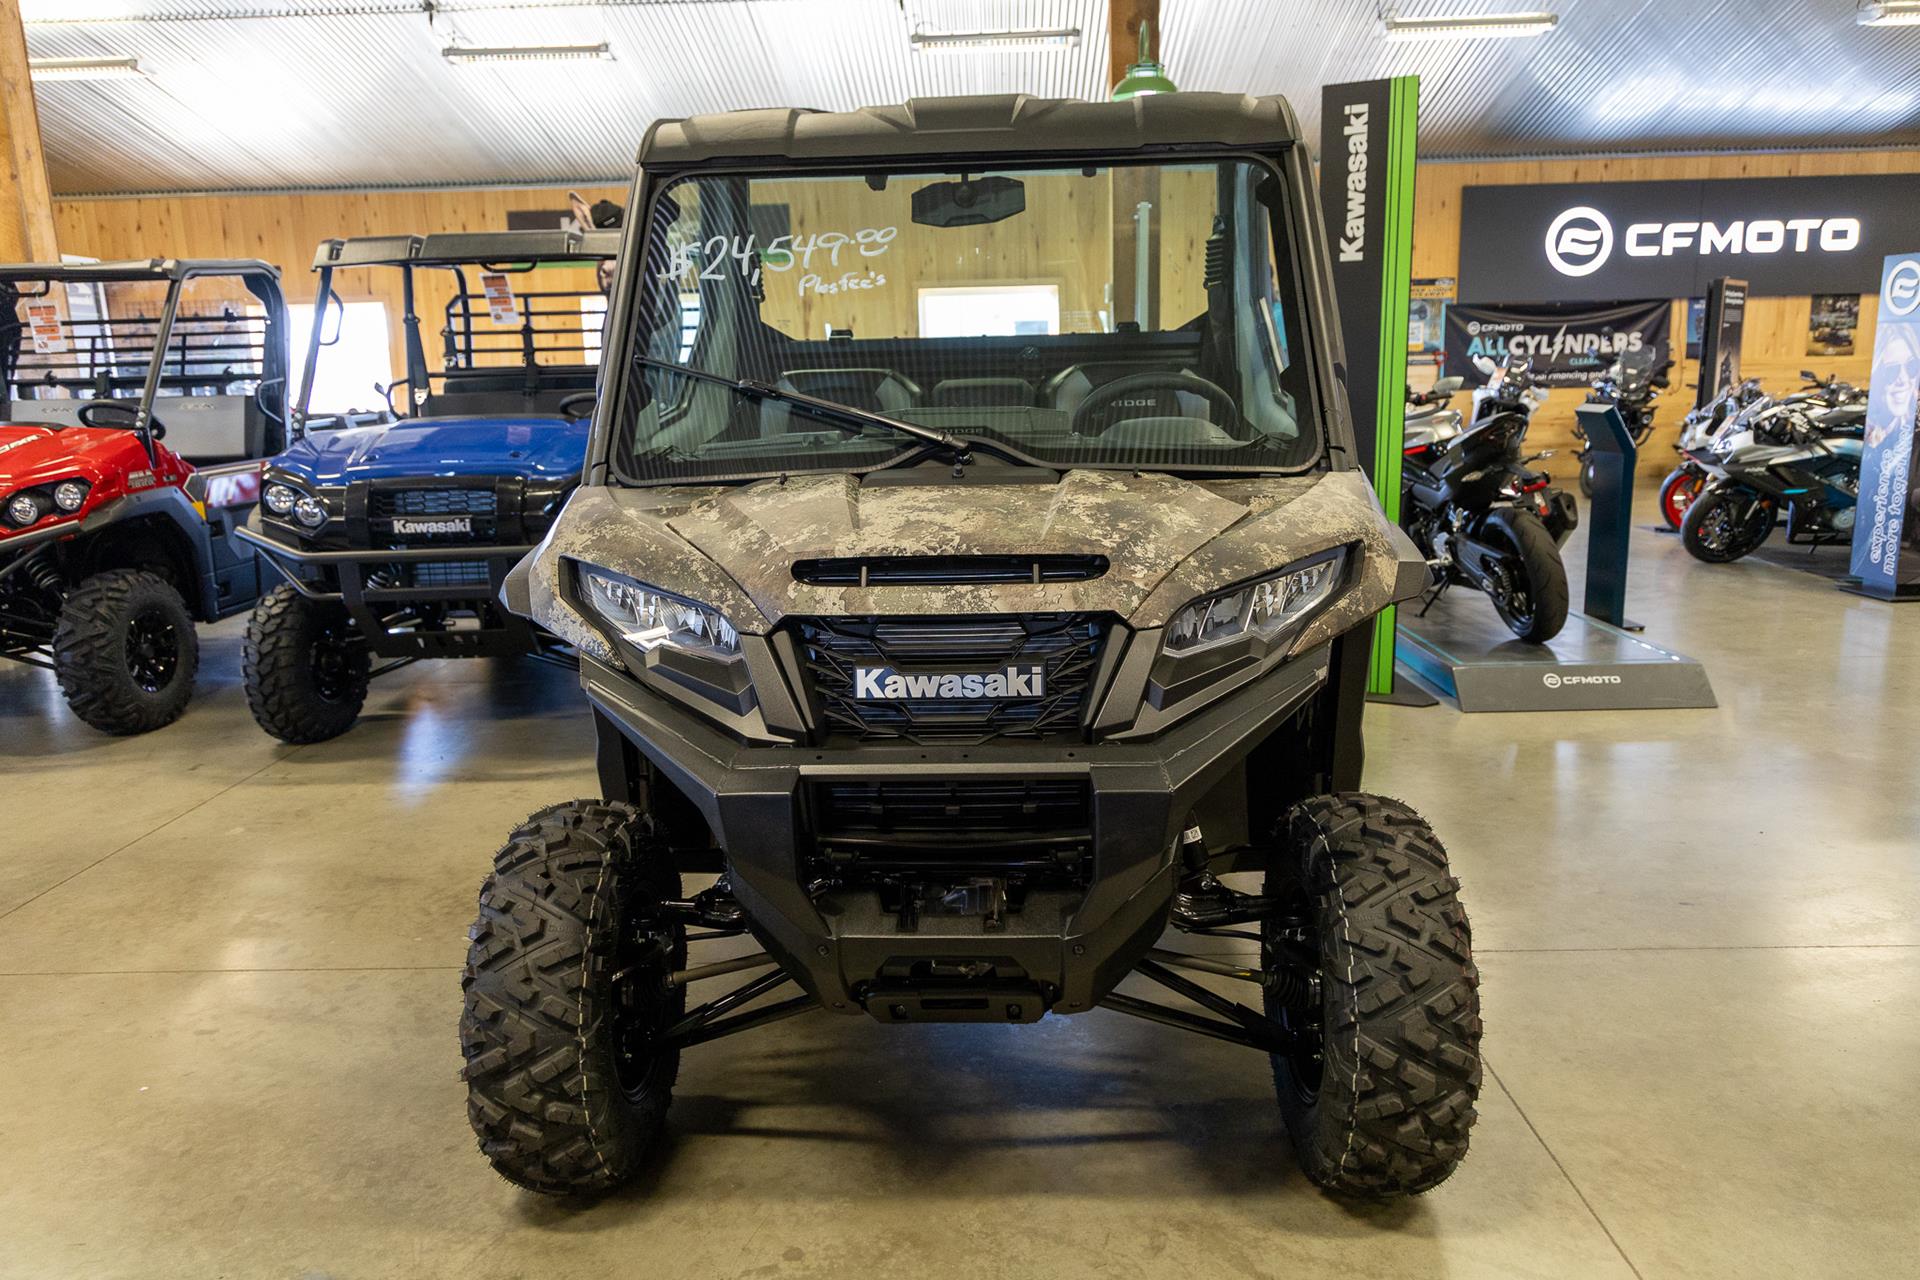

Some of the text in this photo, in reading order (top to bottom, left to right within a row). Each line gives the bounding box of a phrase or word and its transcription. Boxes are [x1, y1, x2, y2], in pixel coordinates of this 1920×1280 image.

[1339, 103, 1369, 262] Kawasaki
[1624, 218, 1861, 257] CFMOTO
[1870, 449, 1894, 564] experience
[393, 519, 471, 534] Kawasaki
[1883, 518, 1900, 576] more
[856, 666, 1042, 699] Kawasaki
[1562, 675, 1621, 684] CFMOTO
